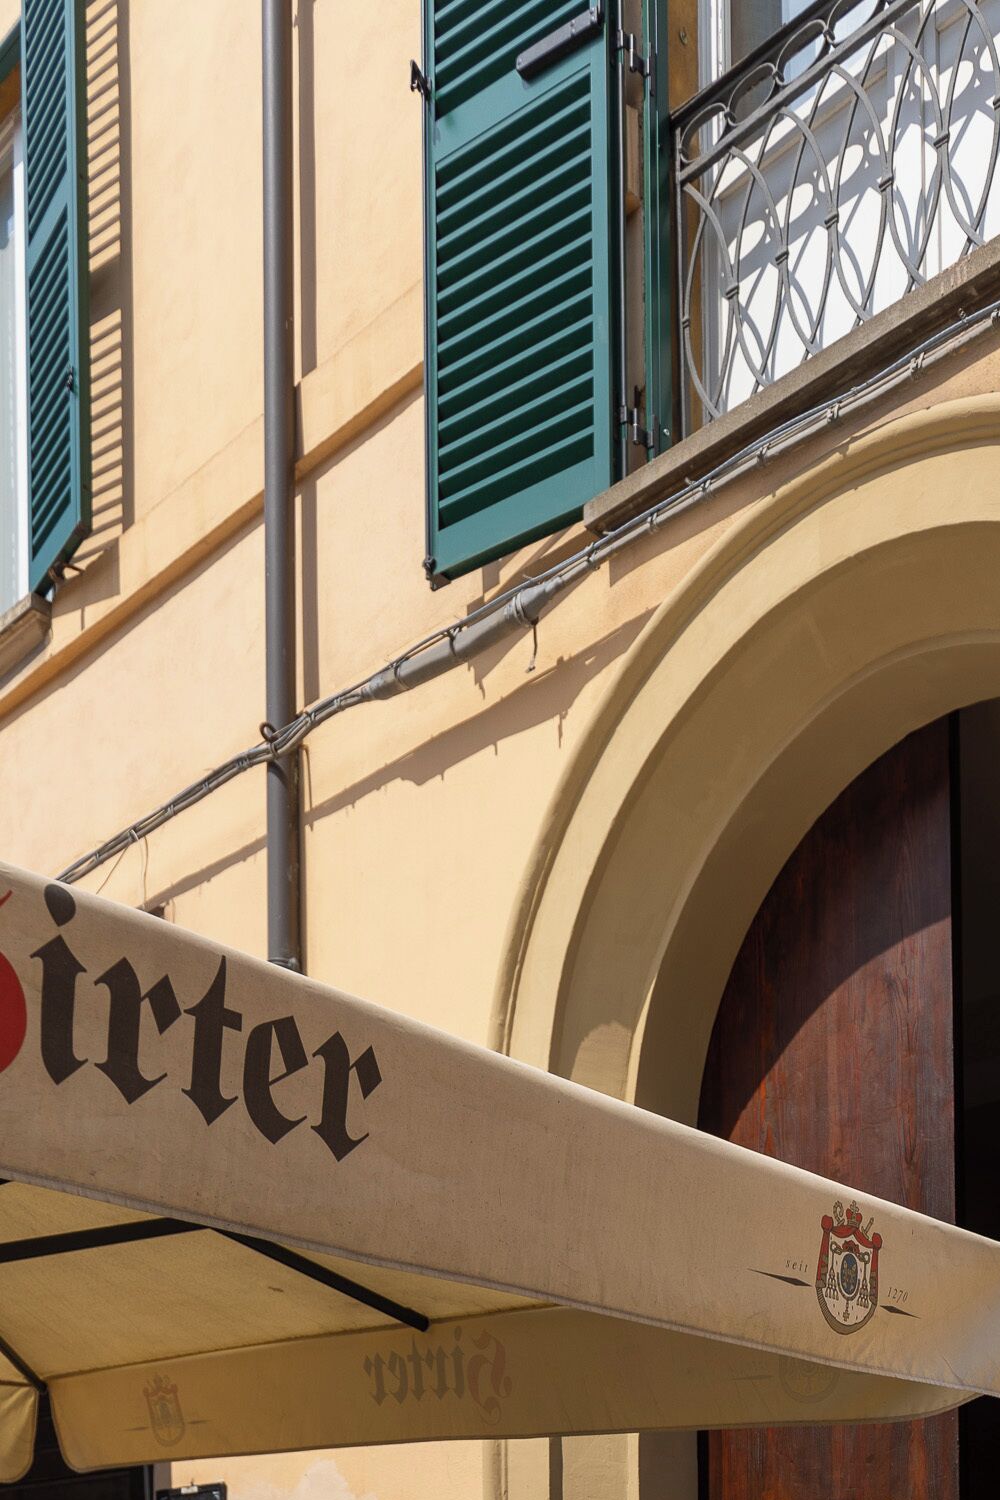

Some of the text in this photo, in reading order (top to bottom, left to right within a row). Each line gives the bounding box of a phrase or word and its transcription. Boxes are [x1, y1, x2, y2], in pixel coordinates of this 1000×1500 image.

[0, 883, 383, 1163] irter
[785, 1258, 909, 1304] seit 1270
